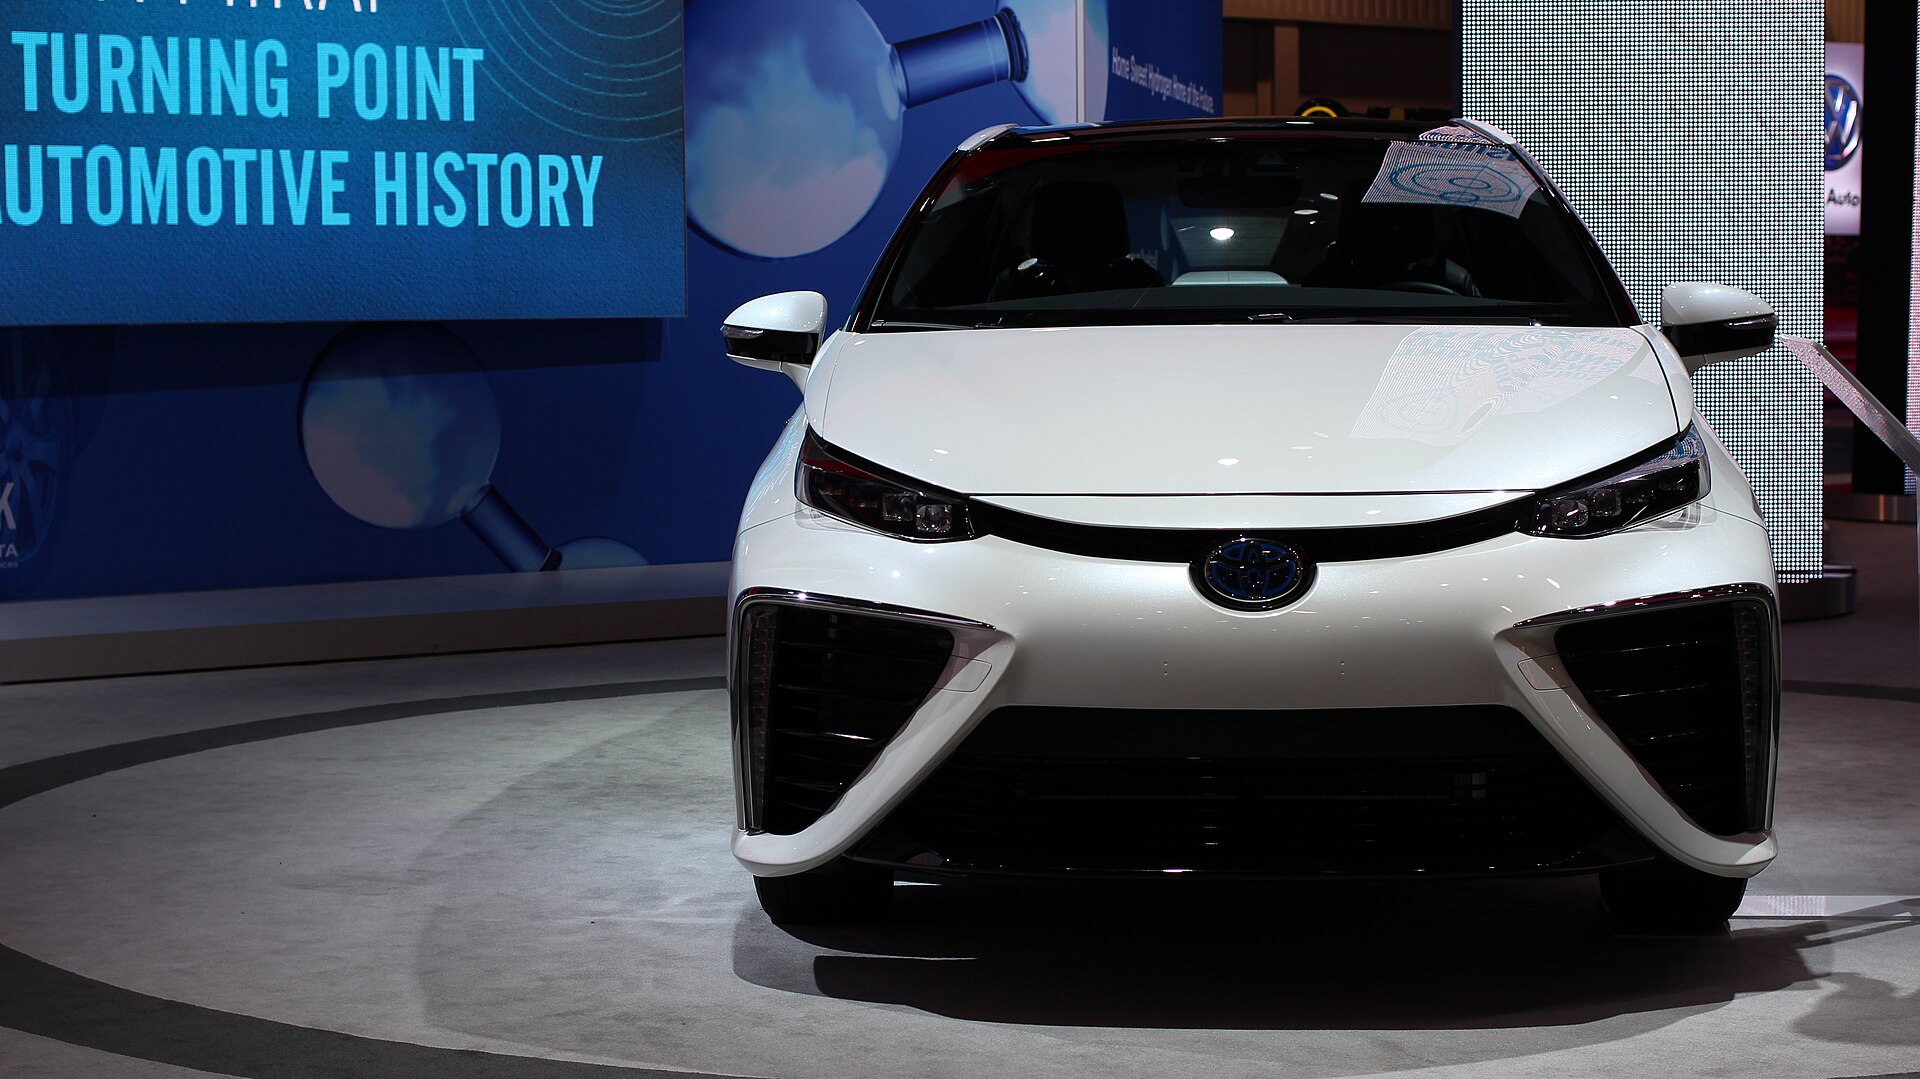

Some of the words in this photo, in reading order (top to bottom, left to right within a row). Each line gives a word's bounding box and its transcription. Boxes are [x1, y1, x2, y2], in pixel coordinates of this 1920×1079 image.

[11, 30, 289, 119] TURNING
[316, 41, 484, 122] POINT
[1112, 46, 1129, 79] Home
[0, 144, 351, 227] UTOMOTIVE
[374, 150, 603, 228] HISTORY
[1826, 188, 1860, 206] Auto
